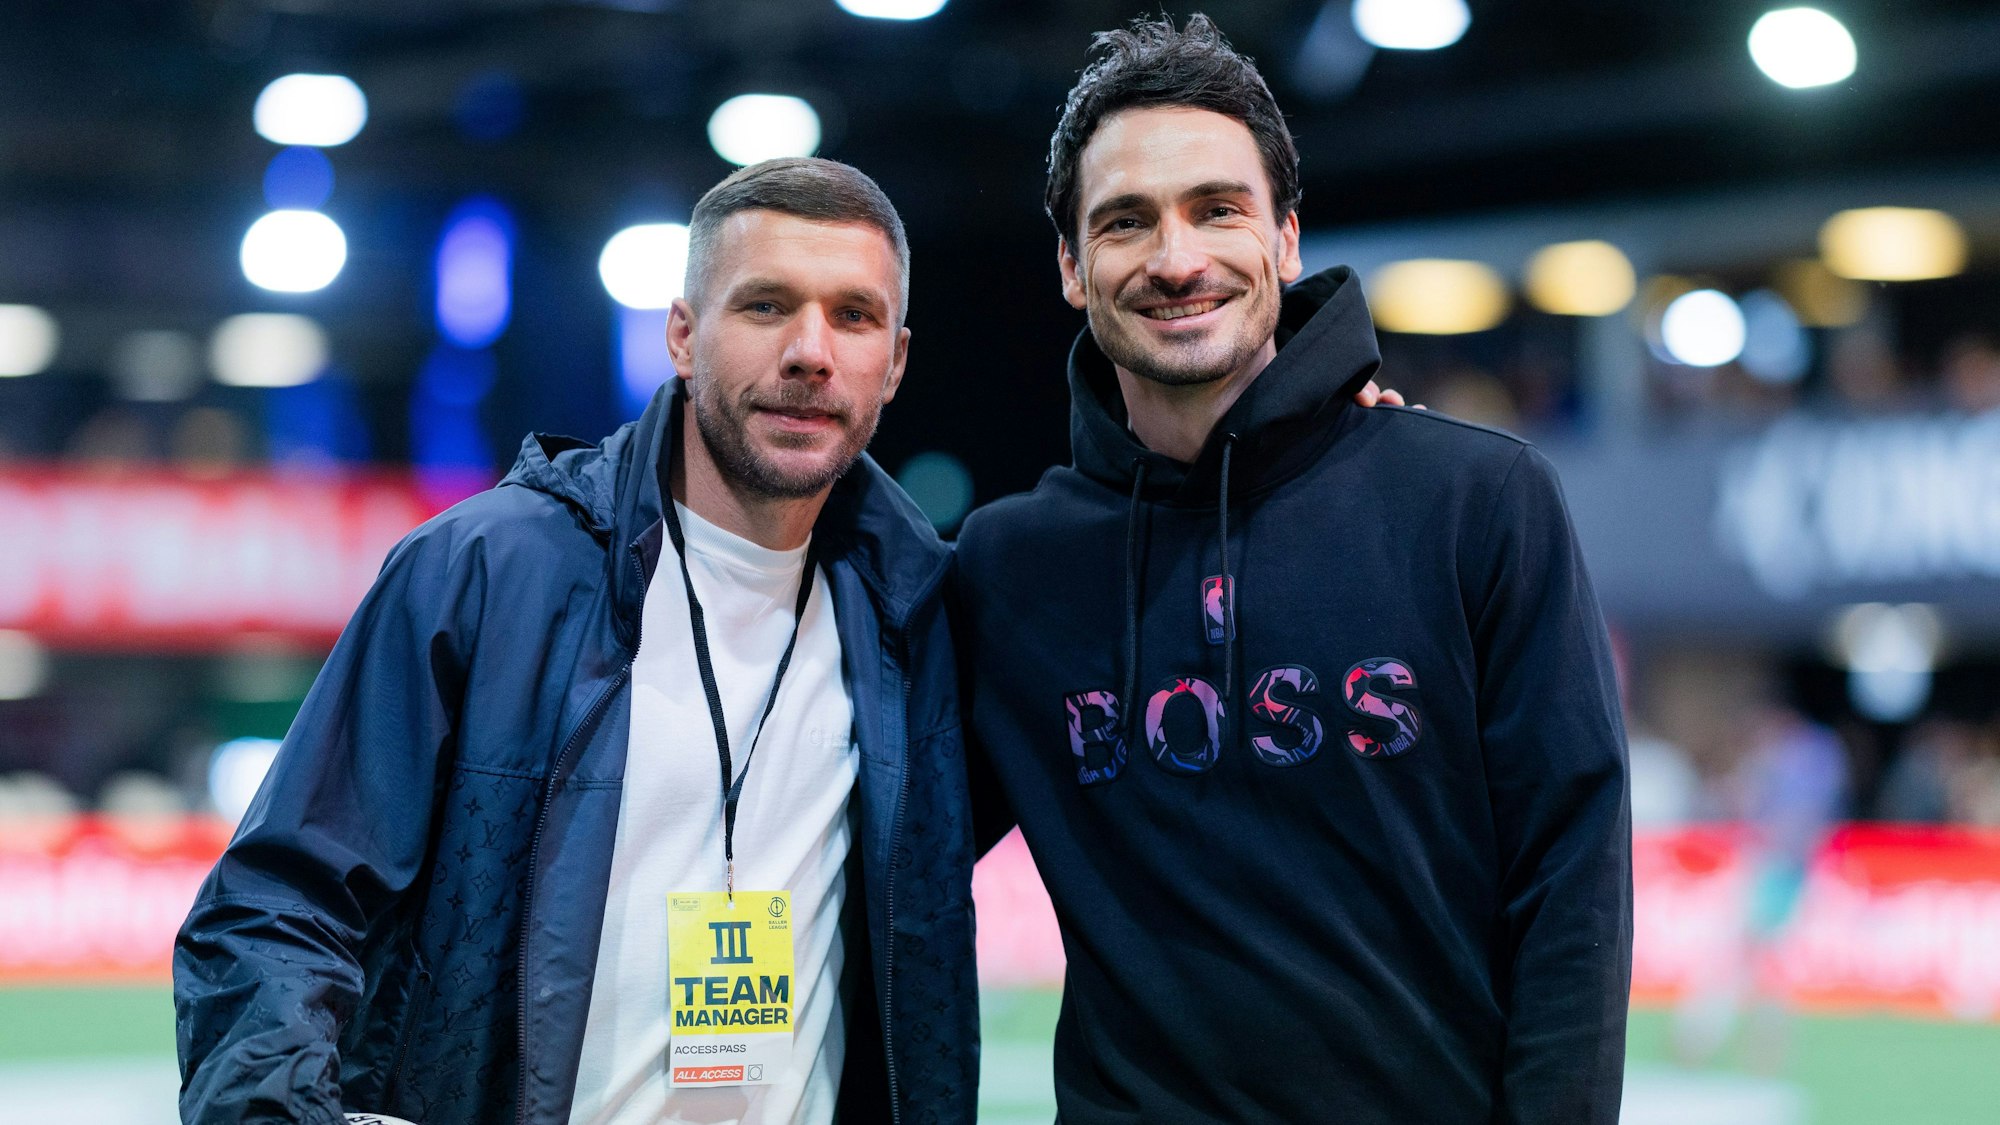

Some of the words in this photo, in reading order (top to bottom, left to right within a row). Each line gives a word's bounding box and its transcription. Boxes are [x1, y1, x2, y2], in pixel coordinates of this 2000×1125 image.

[1064, 656, 1423, 787] BOSS
[1390, 734, 1411, 755] NBA
[675, 975, 789, 1006] TEAM
[676, 1008, 788, 1027] MANAGER
[675, 1045, 717, 1055] ACCESS
[719, 1044, 746, 1053] PASS
[675, 1070, 697, 1080] ALL
[699, 1069, 742, 1080] ACCESS
